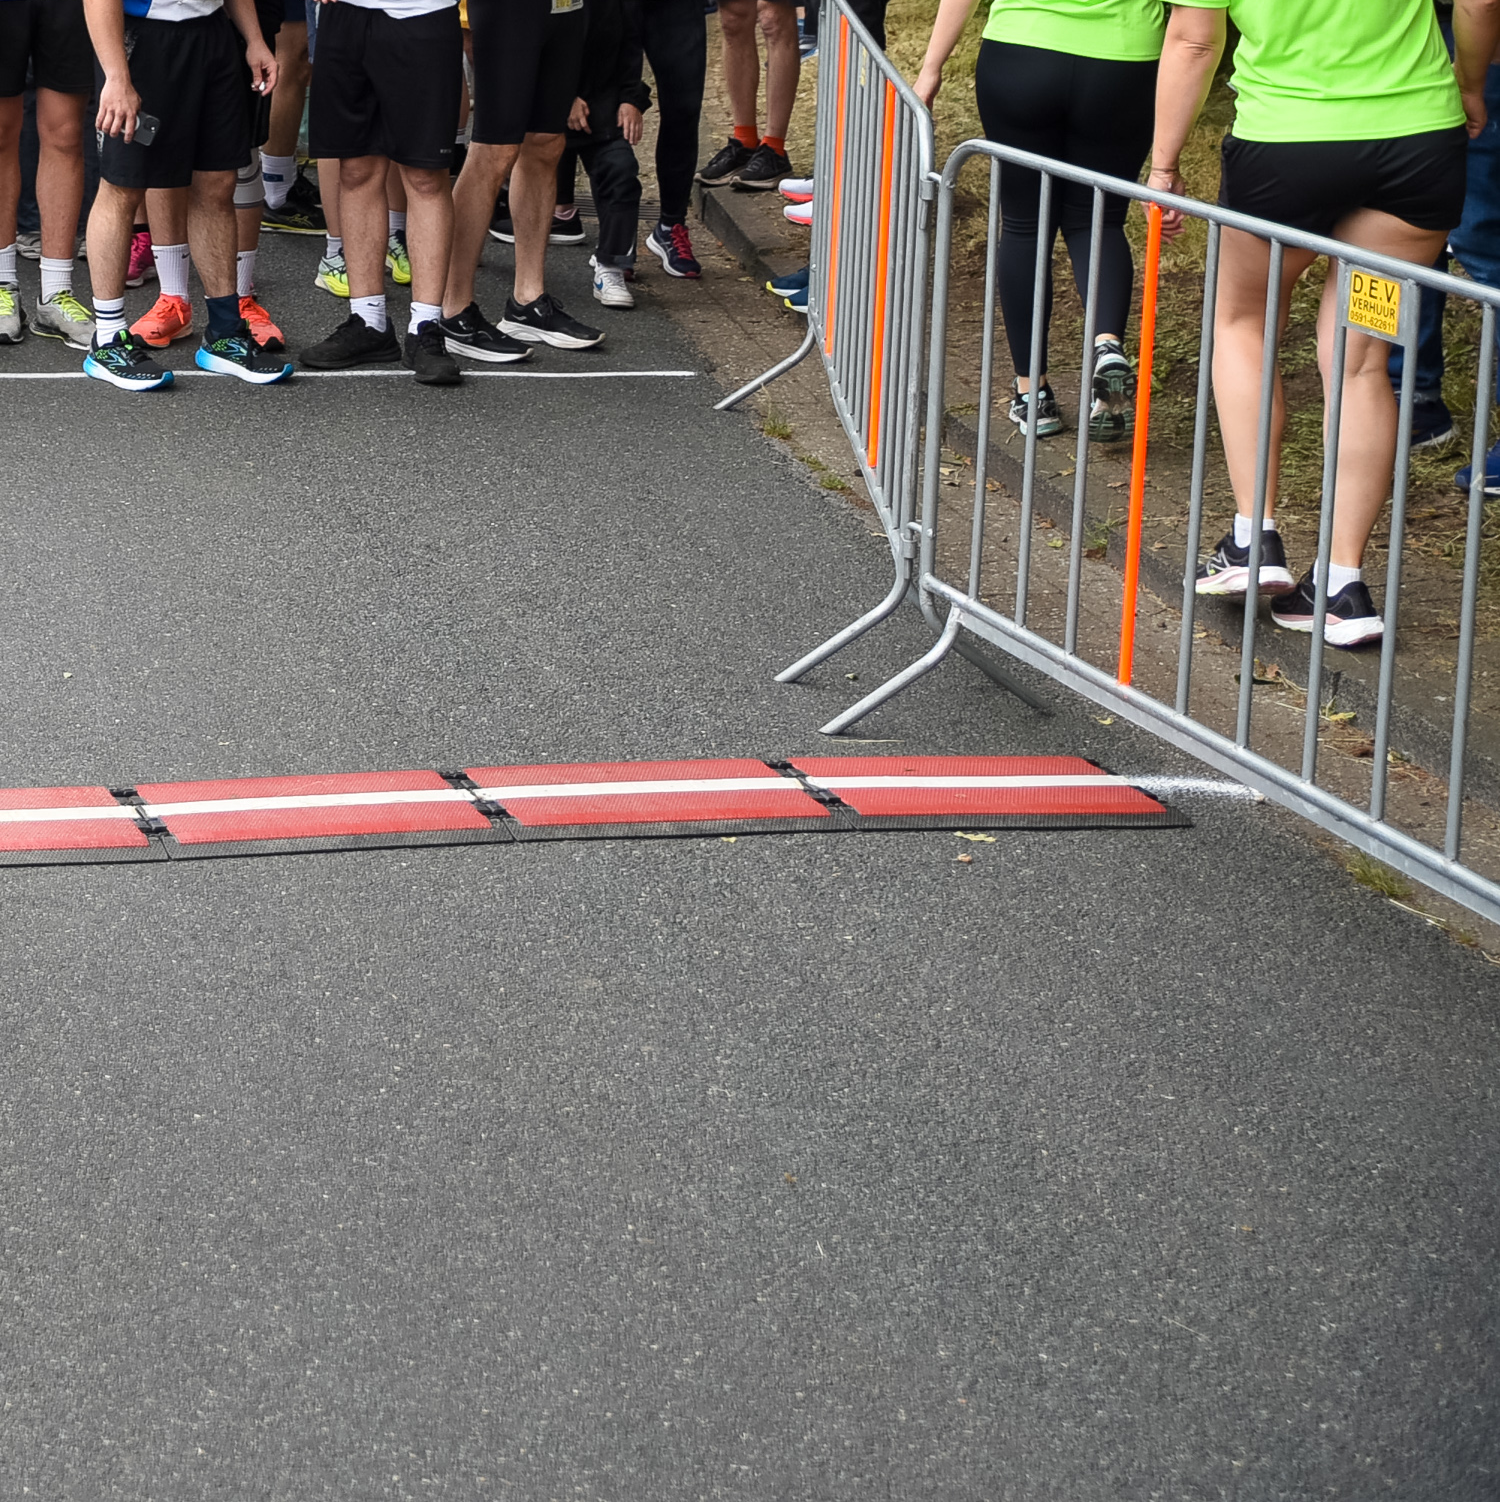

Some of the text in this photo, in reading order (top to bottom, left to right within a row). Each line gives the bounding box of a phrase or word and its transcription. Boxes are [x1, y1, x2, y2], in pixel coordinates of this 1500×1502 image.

[1352, 273, 1397, 306] D.E.V.
[1351, 295, 1396, 321] VERHUUR
[1349, 310, 1395, 333] 0591-622611
